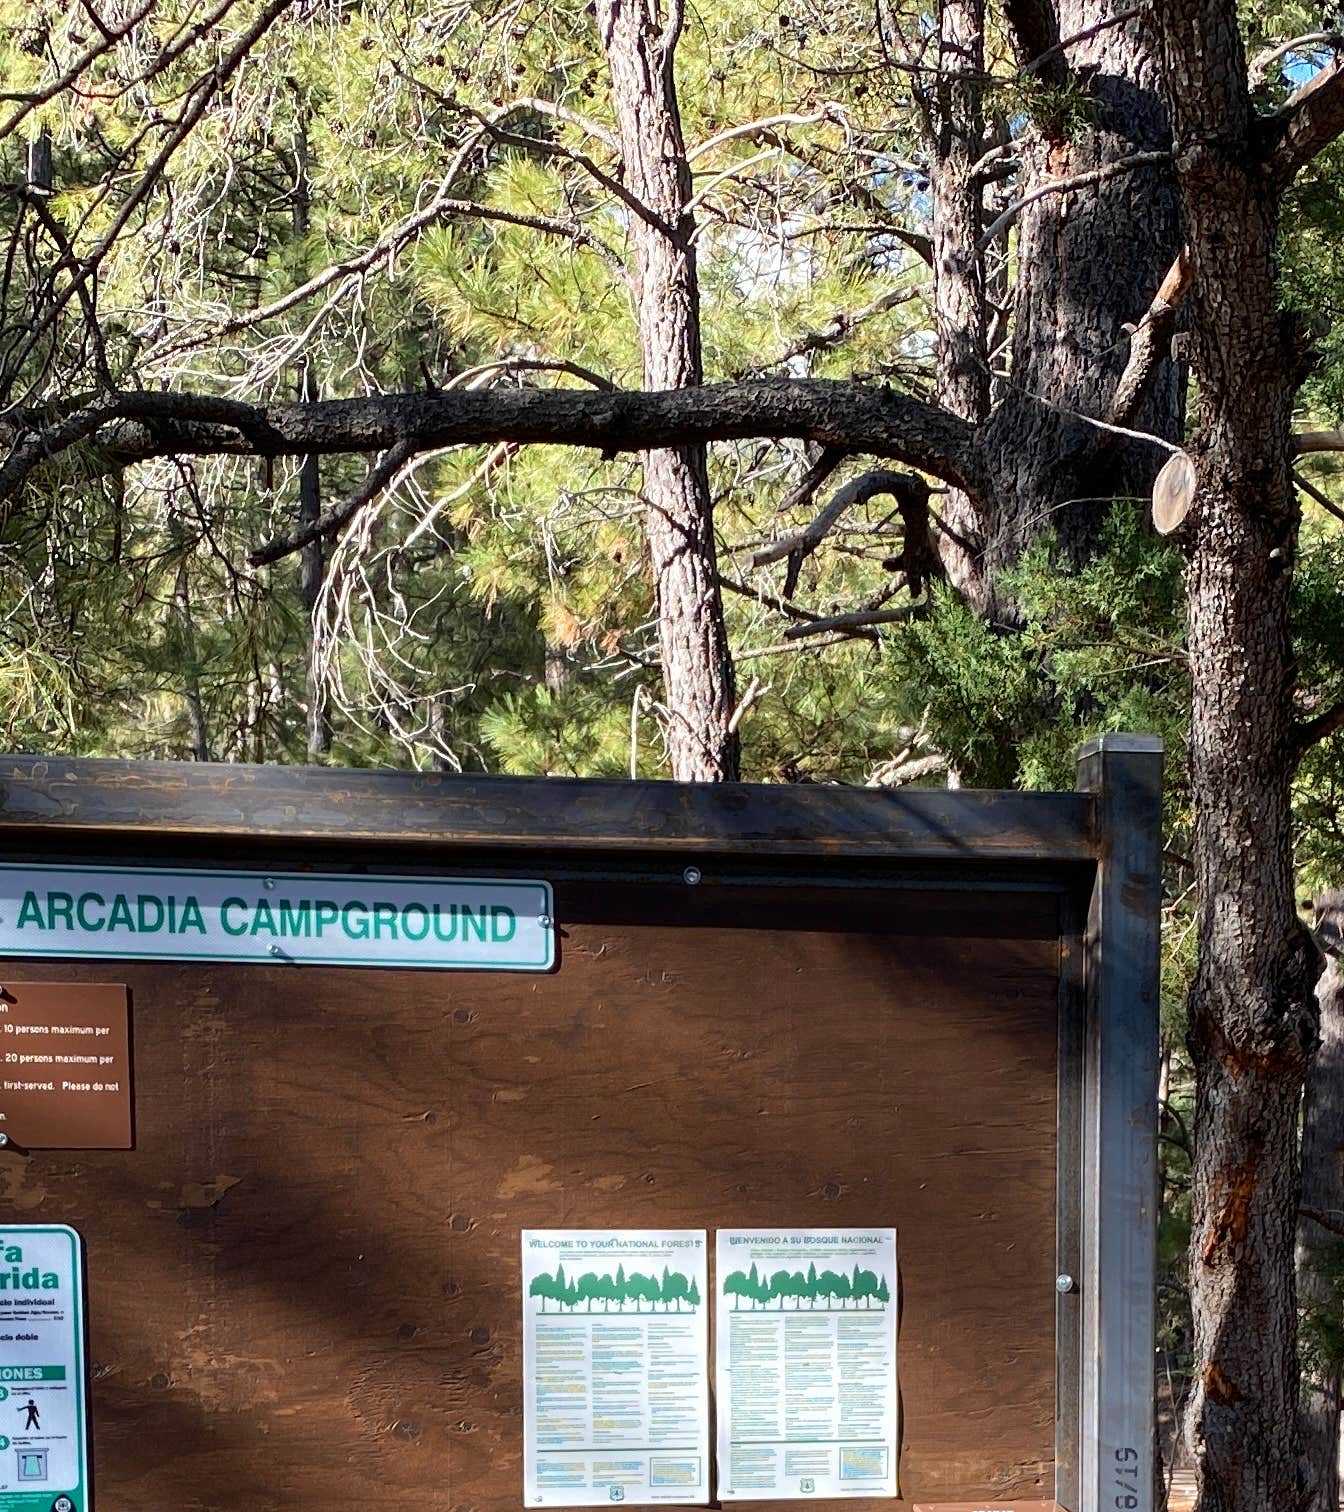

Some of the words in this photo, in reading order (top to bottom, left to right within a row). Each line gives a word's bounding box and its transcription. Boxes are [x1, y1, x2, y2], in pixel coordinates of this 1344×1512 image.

[17, 891, 206, 934] ARCADIA
[220, 897, 516, 942] CAMPGROUND
[4, 1025, 14, 1034] 10
[15, 1026, 49, 1036] persons
[51, 1025, 94, 1035] maximum
[95, 1026, 110, 1037] per
[5, 1053, 18, 1063] 20
[19, 1054, 53, 1064] persons
[55, 1054, 98, 1064] maximum
[99, 1055, 114, 1066] per
[62, 1081, 91, 1091] Please
[92, 1082, 103, 1091] do
[105, 1082, 119, 1091] not
[529, 1239, 574, 1248] WELCOME
[576, 1240, 588, 1248] TO
[590, 1240, 615, 1248] YOUR
[616, 1240, 659, 1248] NATIONAL
[729, 1236, 781, 1245] BIENVENIDO
[790, 1236, 802, 1244] SU
[803, 1236, 839, 1244] BOSQUE
[841, 1236, 883, 1244] NACIONAL
[15, 1333, 39, 1341] doble
